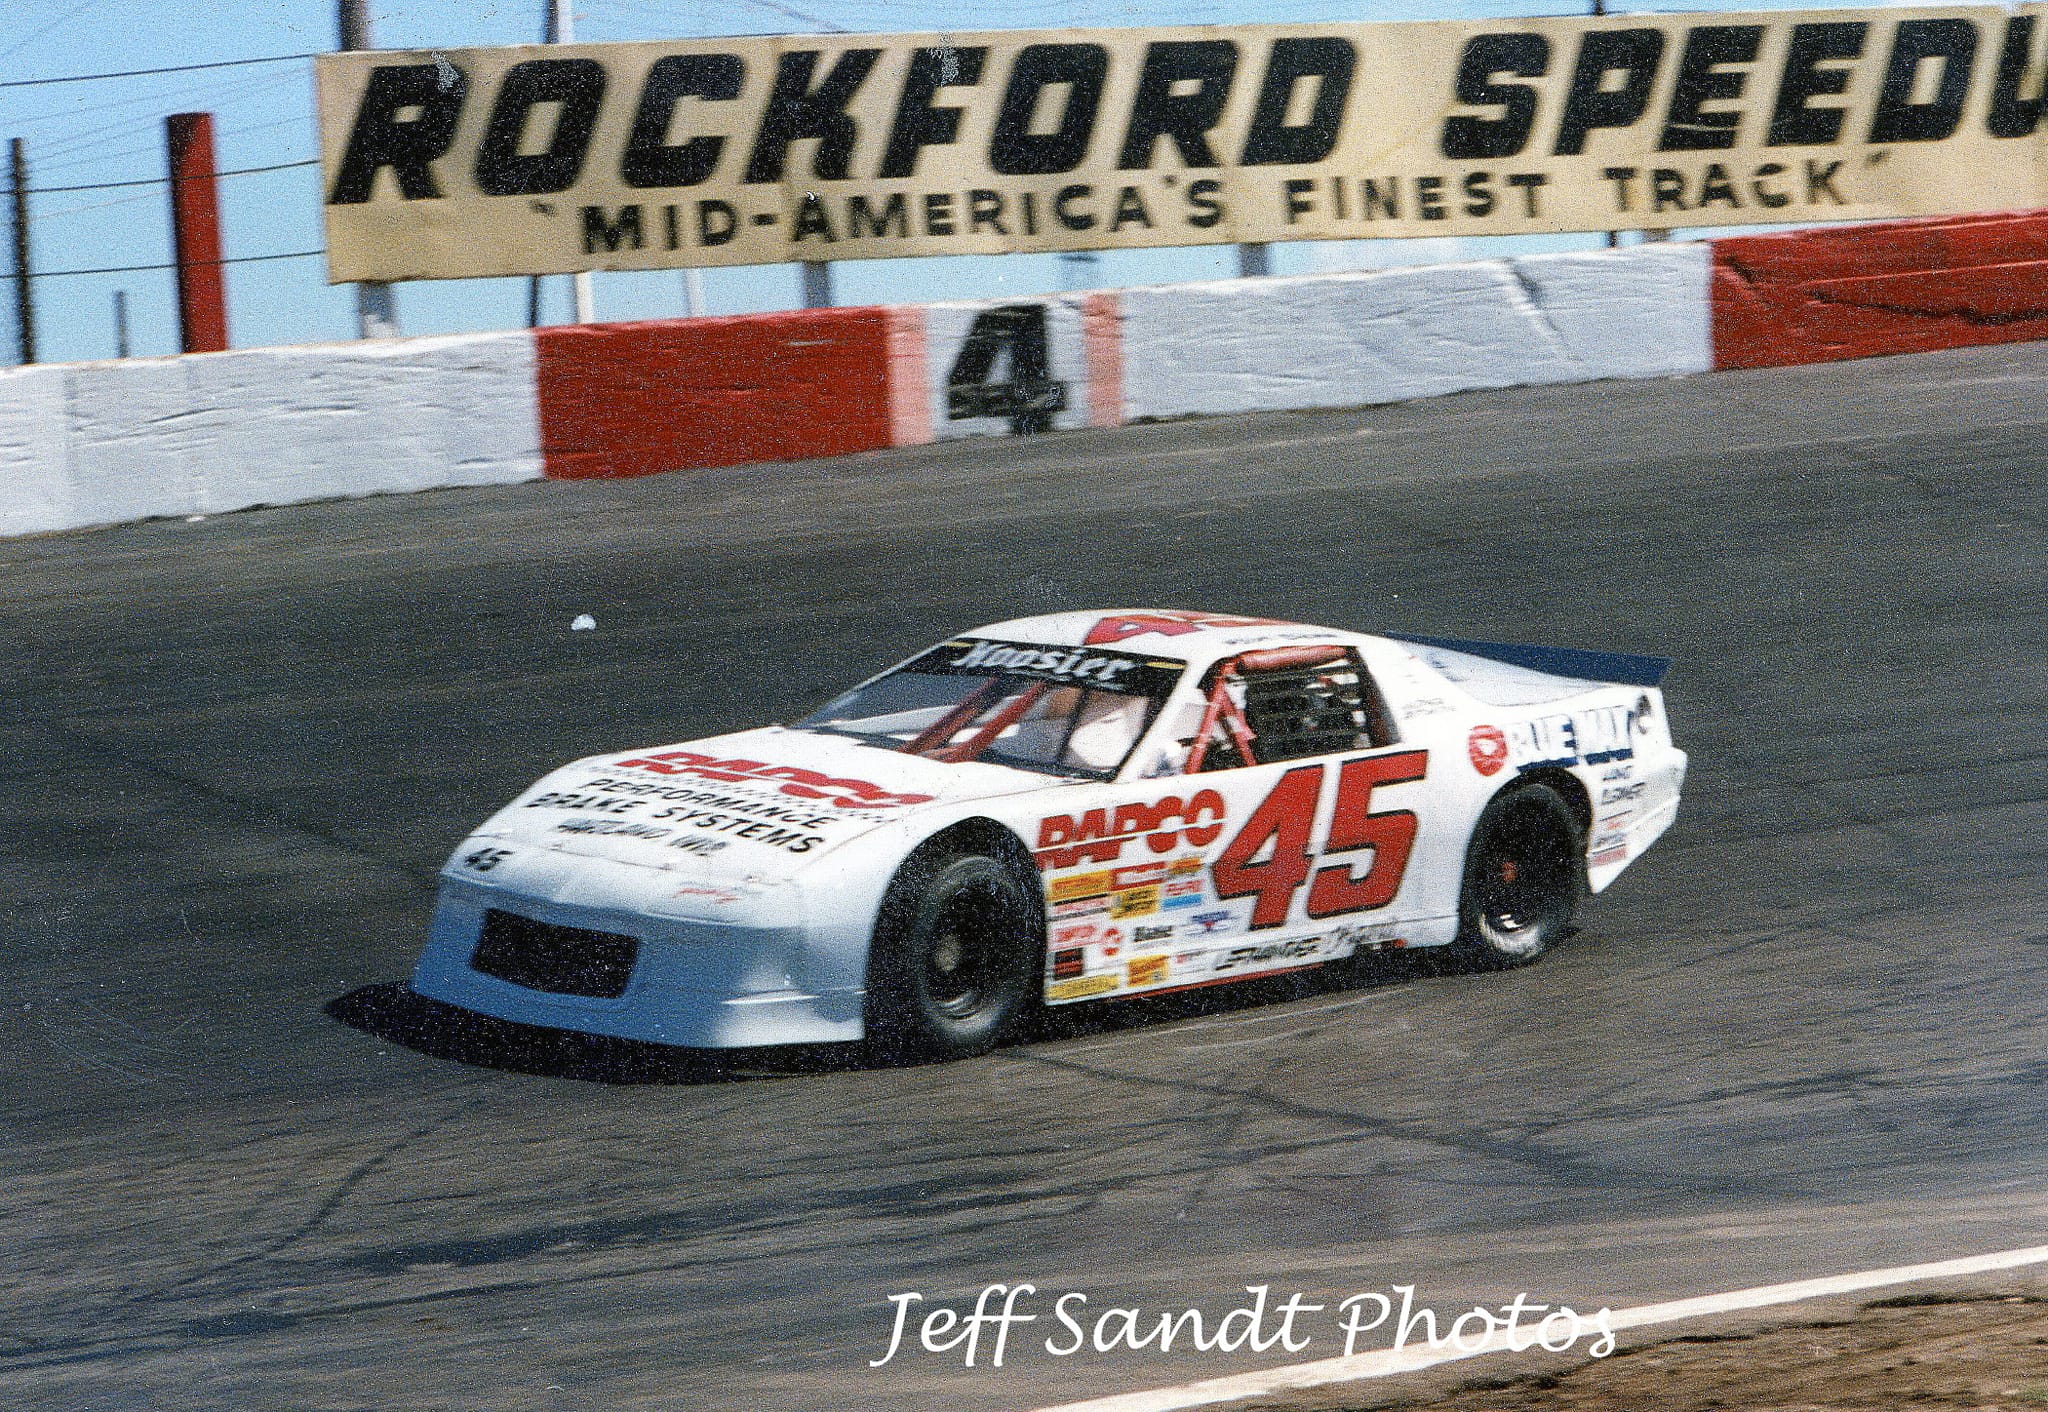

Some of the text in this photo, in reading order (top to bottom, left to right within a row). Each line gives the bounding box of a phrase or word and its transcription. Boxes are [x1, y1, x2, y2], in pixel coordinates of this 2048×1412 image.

[328, 36, 1358, 205] ROCKFORD
[1283, 171, 1548, 225] FINEST
[948, 303, 1067, 434] 4
[951, 641, 1136, 681] Hoosier
[523, 791, 825, 854] BRAKE SYSTEMS
[578, 778, 840, 829] PERFORMANCE
[1034, 789, 1226, 872] RAPCO
[464, 847, 514, 872] 45
[1211, 749, 1429, 931] 45
